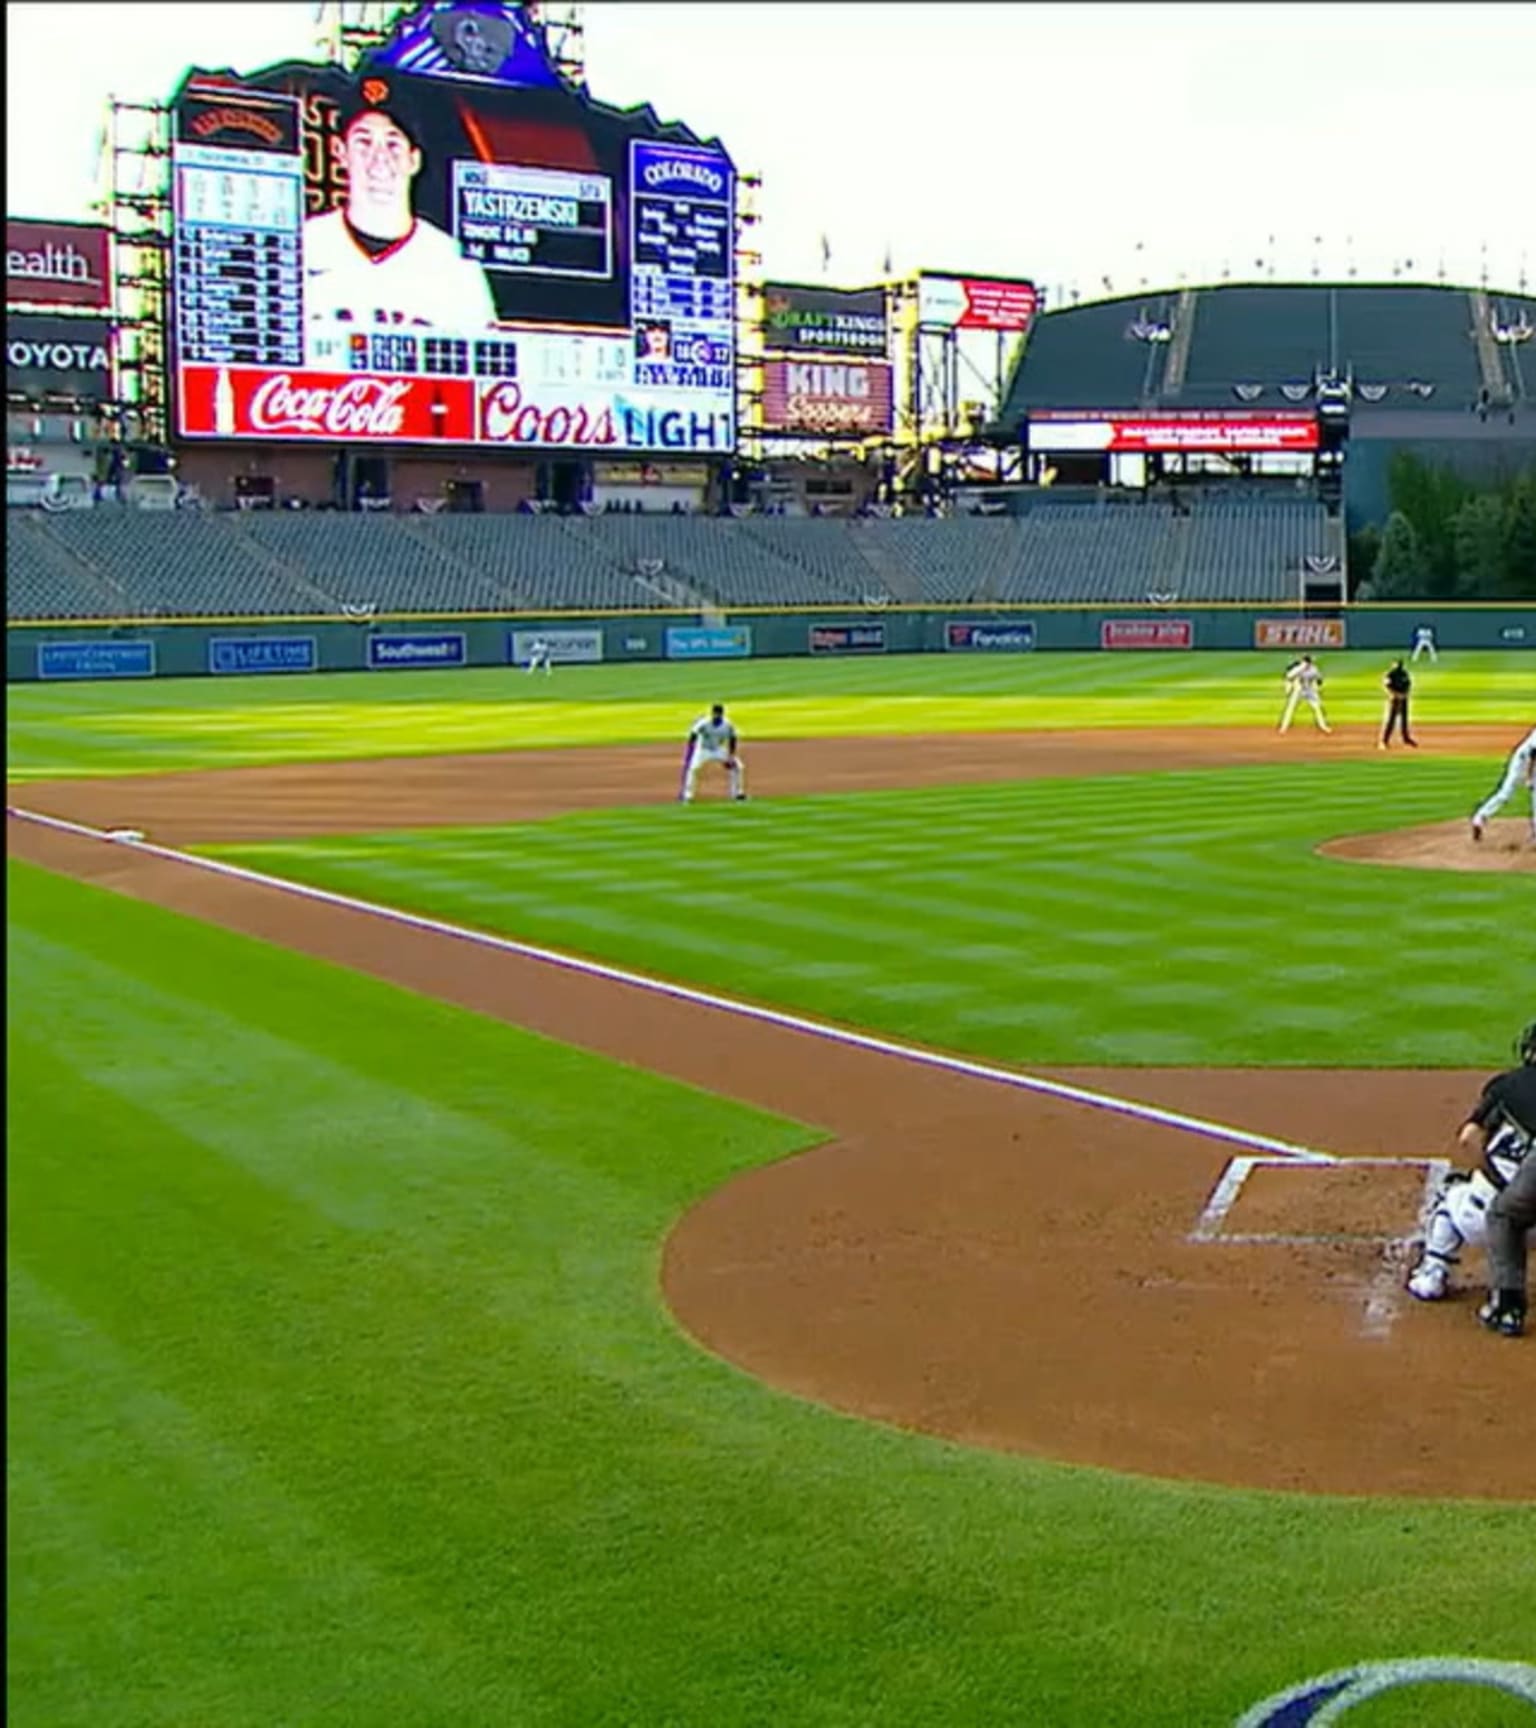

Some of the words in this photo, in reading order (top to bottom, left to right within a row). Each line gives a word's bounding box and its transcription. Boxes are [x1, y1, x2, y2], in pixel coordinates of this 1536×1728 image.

[643, 162, 723, 193] COLORADO
[463, 191, 579, 228] YASTRZEMSKI
[7, 344, 109, 370] OYOTA
[786, 363, 868, 397] KING
[480, 381, 617, 446] Coors
[970, 629, 1032, 646] Fanatics
[1264, 625, 1339, 644] STIHL
[376, 641, 447, 660] Southwest
